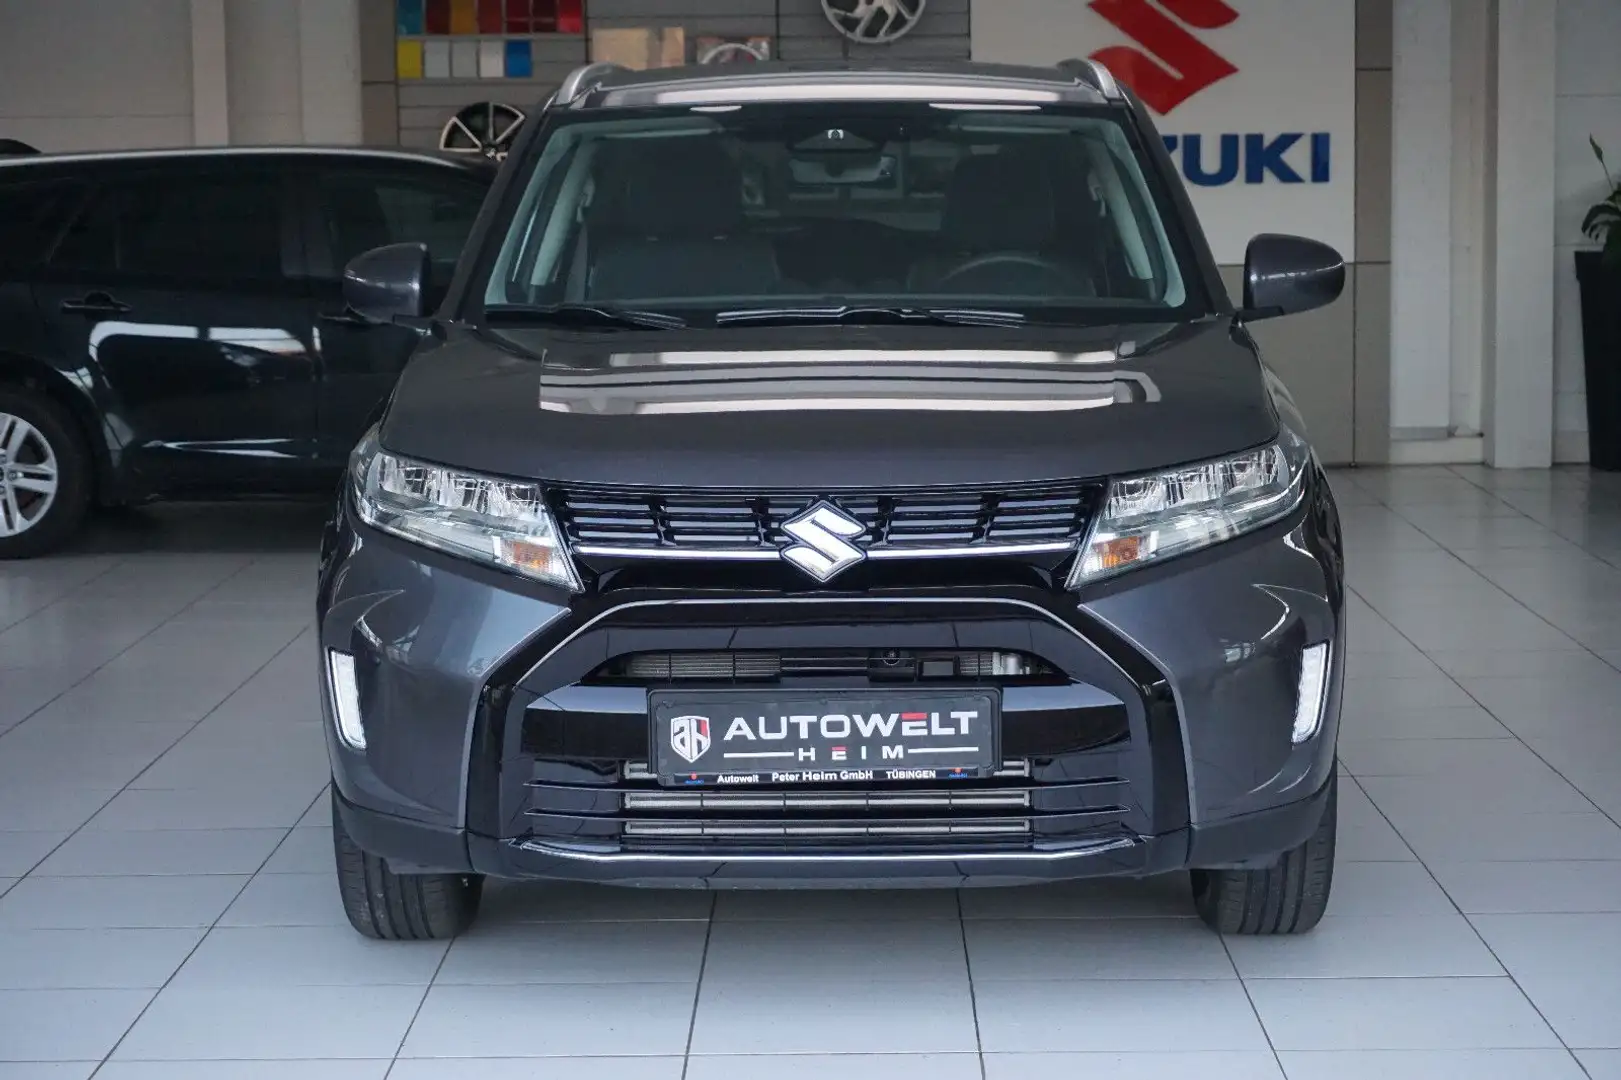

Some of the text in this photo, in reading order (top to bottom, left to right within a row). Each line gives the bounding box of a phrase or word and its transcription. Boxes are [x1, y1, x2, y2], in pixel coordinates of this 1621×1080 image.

[1161, 132, 1330, 187] UKI
[723, 711, 978, 741] AUTOWELT
[798, 745, 904, 762] HEIM
[717, 769, 937, 783] Autowelt Peter Heim GmbH TÜBINGEN
